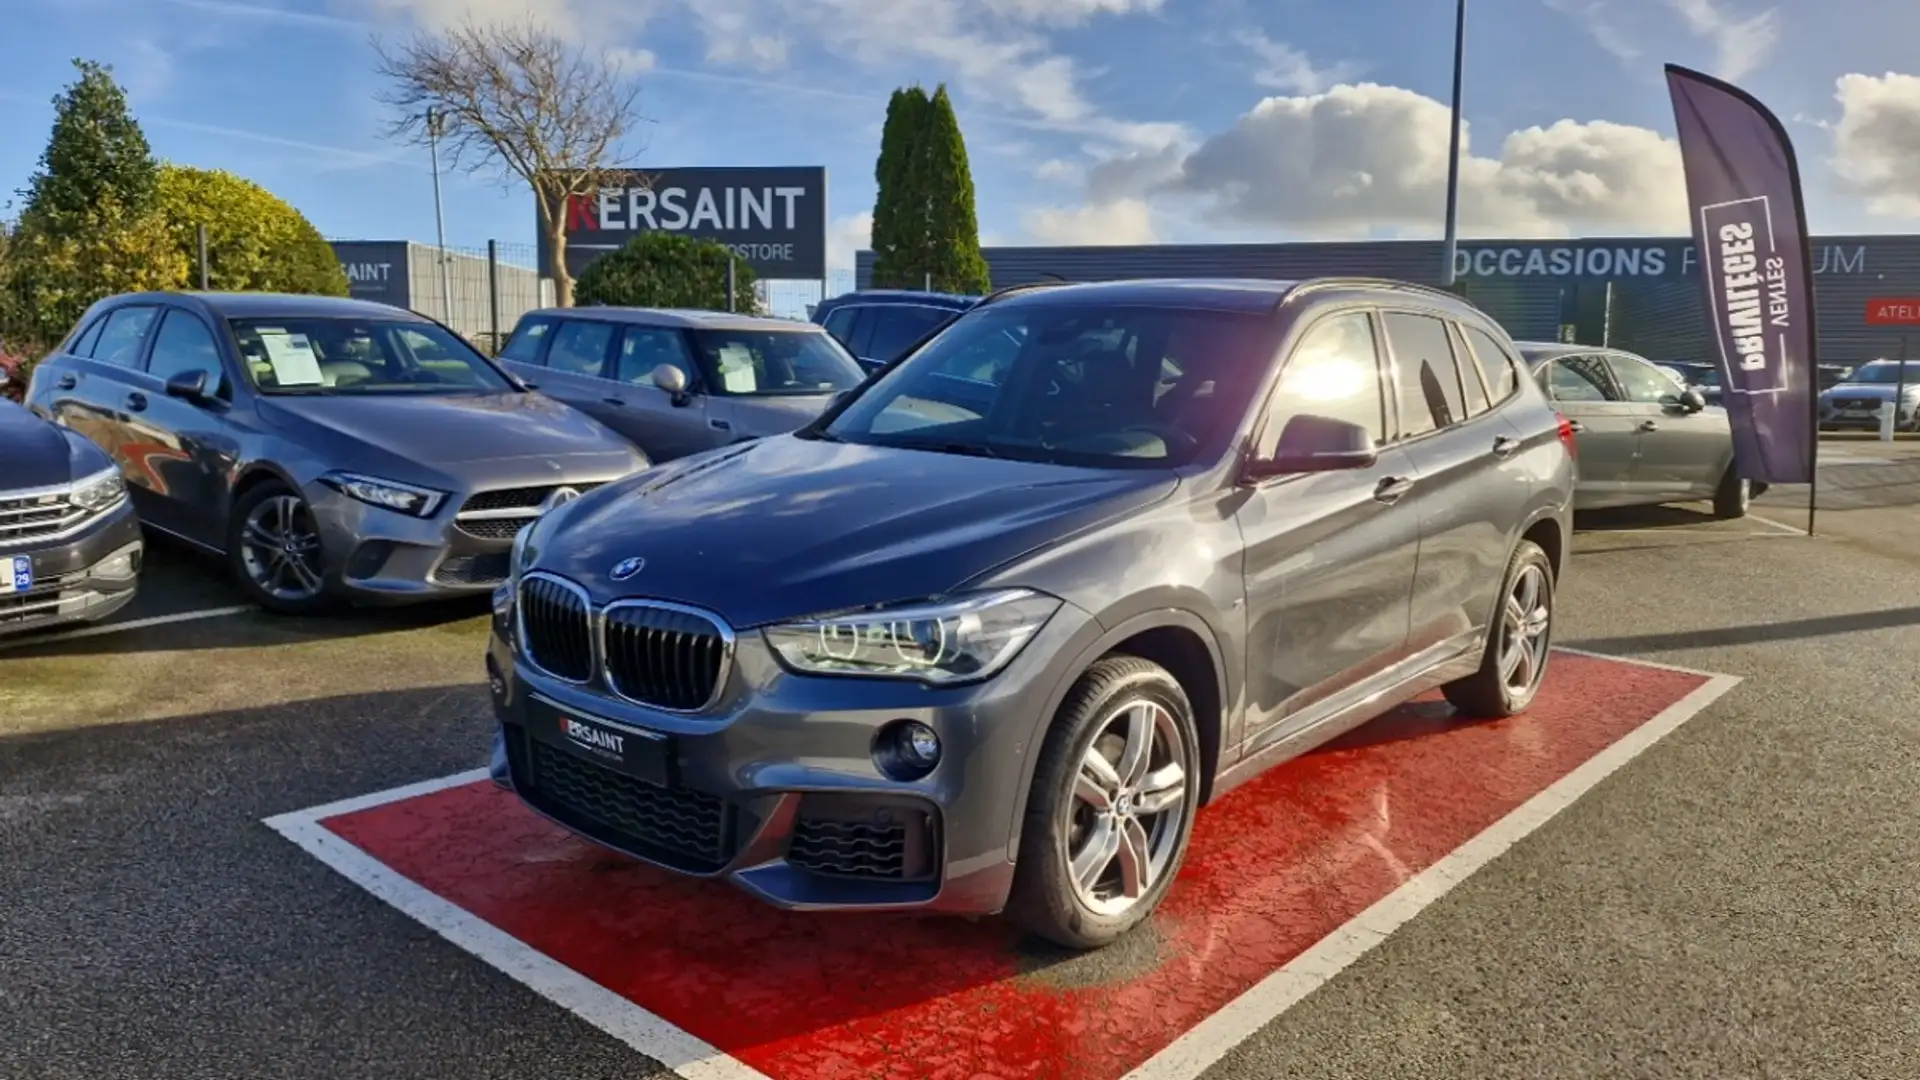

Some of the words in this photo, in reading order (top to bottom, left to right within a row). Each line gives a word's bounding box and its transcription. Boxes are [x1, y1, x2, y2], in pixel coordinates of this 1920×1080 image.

[567, 187, 805, 230] KERSAINT
[1454, 247, 1666, 276] OCCASIONS
[15, 573, 29, 585] 29
